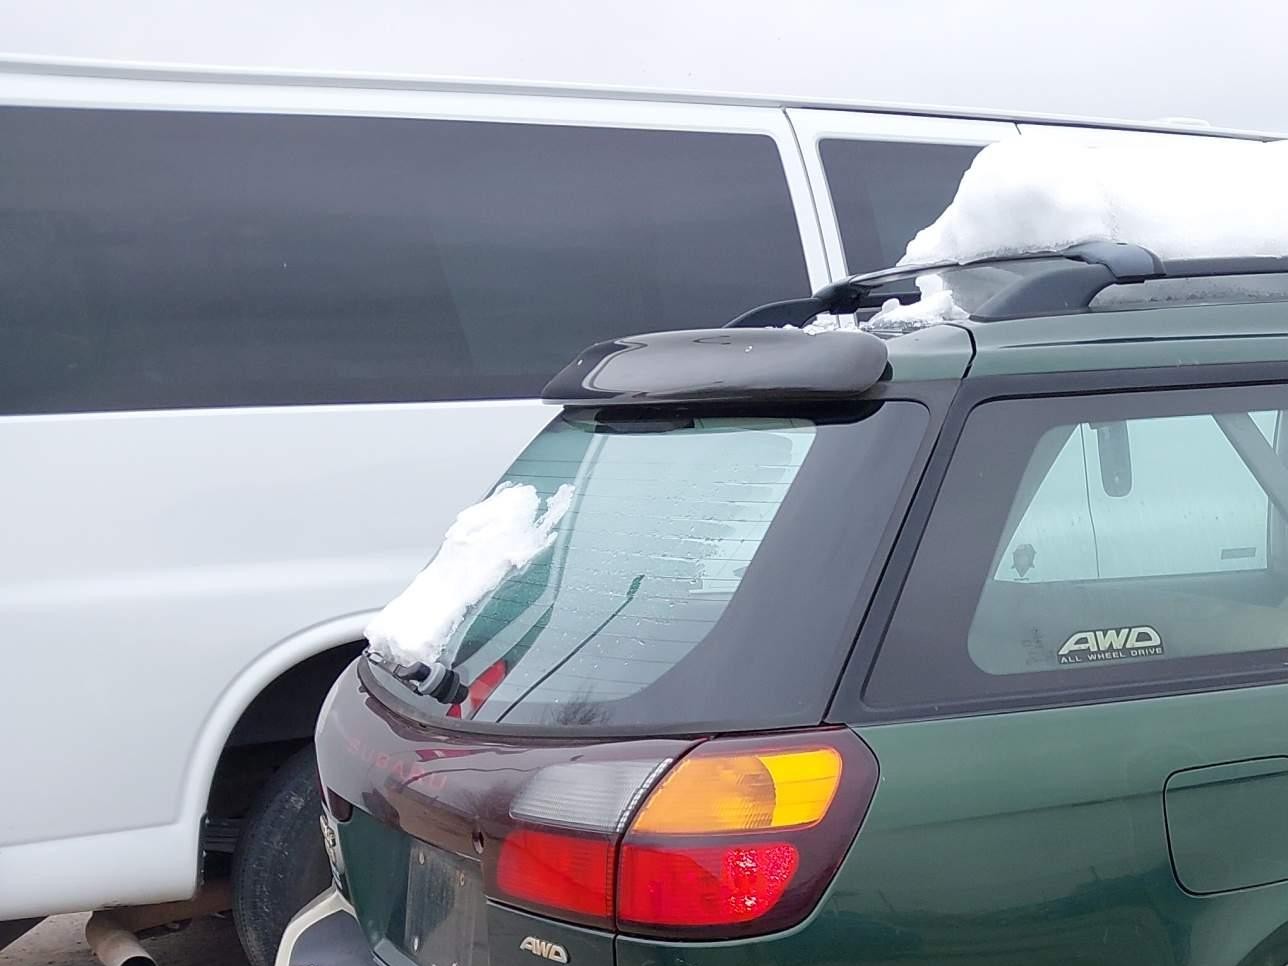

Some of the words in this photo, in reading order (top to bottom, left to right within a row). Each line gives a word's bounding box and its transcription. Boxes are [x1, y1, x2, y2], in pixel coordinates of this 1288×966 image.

[1058, 625, 1162, 656] AWD
[1060, 655, 1083, 664] ALL
[1087, 650, 1127, 662] WHEEL
[1130, 647, 1163, 657] DRIVE
[519, 935, 569, 964] AWD
